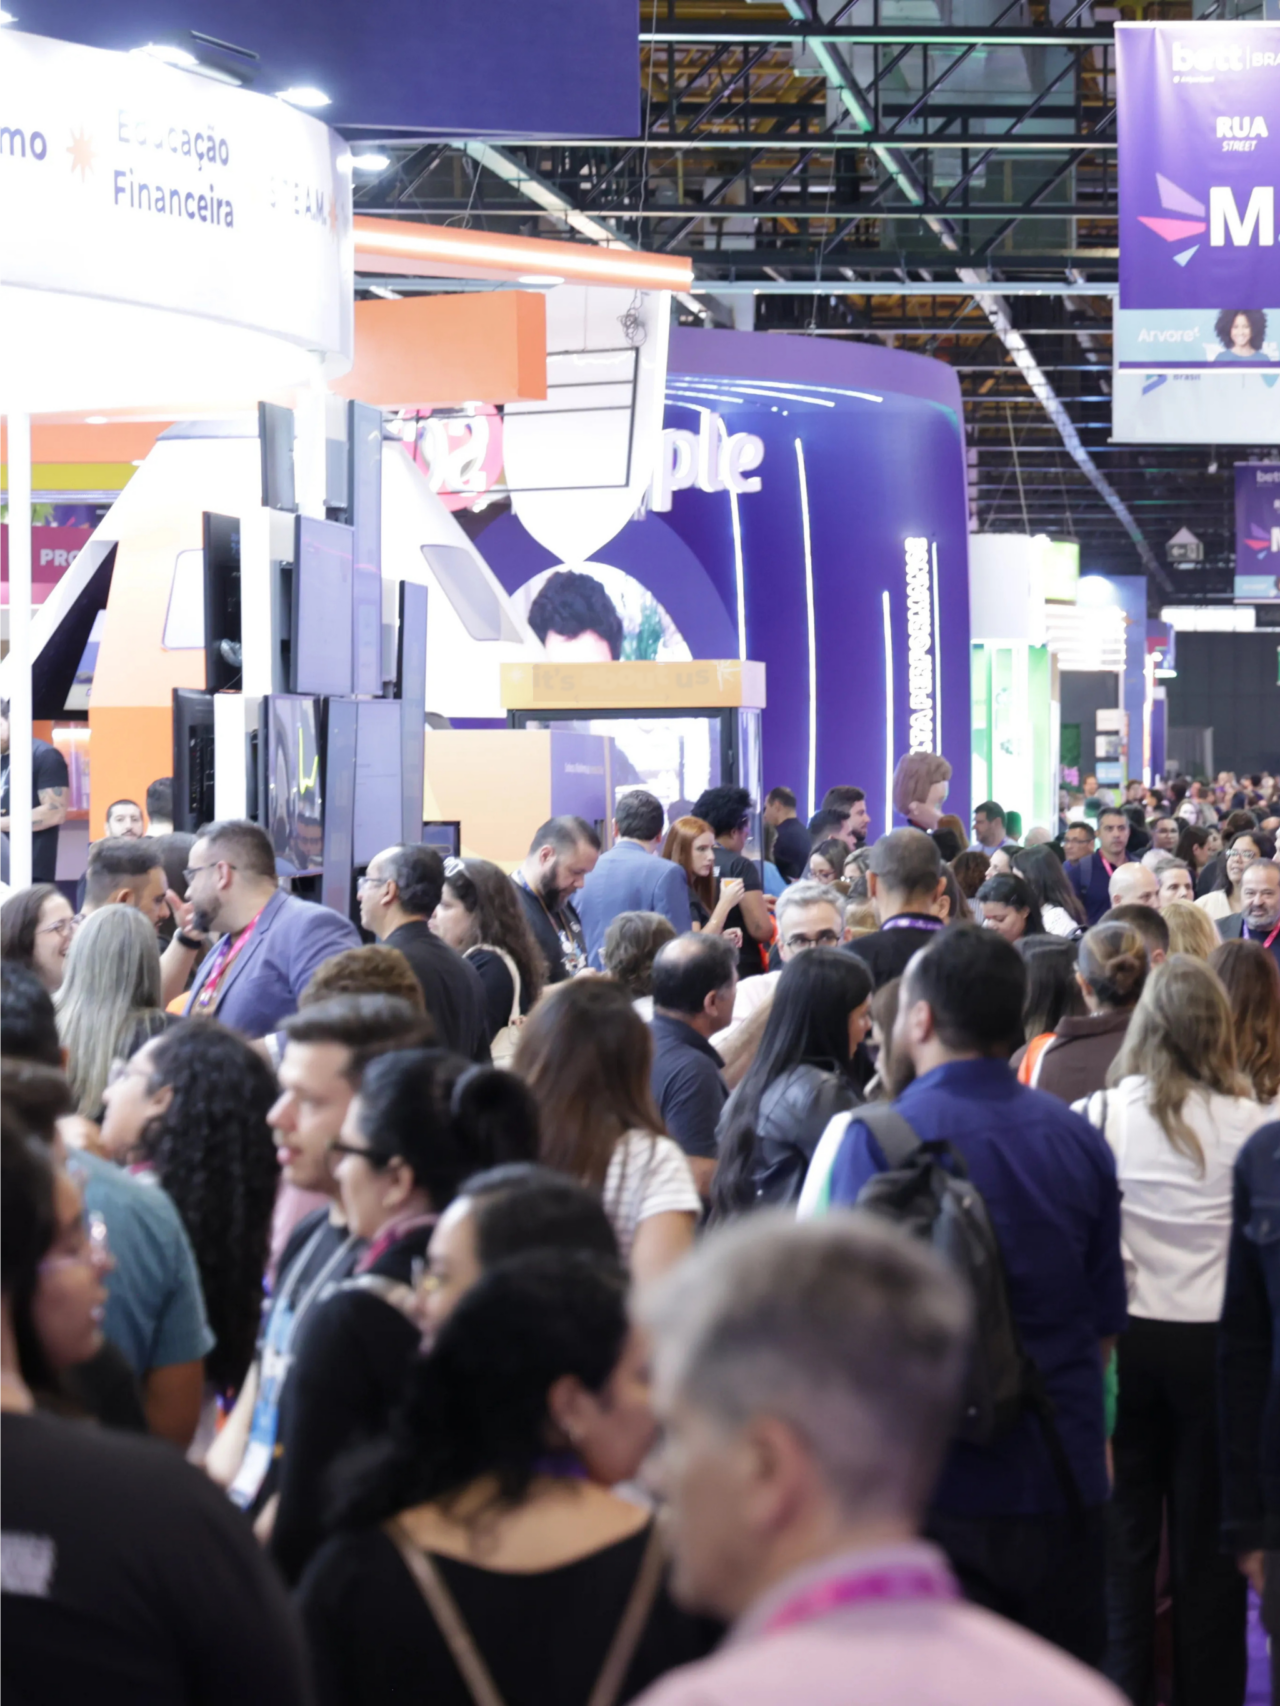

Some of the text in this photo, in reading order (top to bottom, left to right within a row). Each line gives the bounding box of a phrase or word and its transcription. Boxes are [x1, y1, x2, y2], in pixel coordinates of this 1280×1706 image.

[1172, 41, 1243, 71] bett
[1216, 116, 1269, 138] RUA
[1222, 140, 1258, 152] STREET
[113, 168, 234, 229] Financeira
[1209, 186, 1275, 247] M
[532, 663, 710, 692] it's about us
